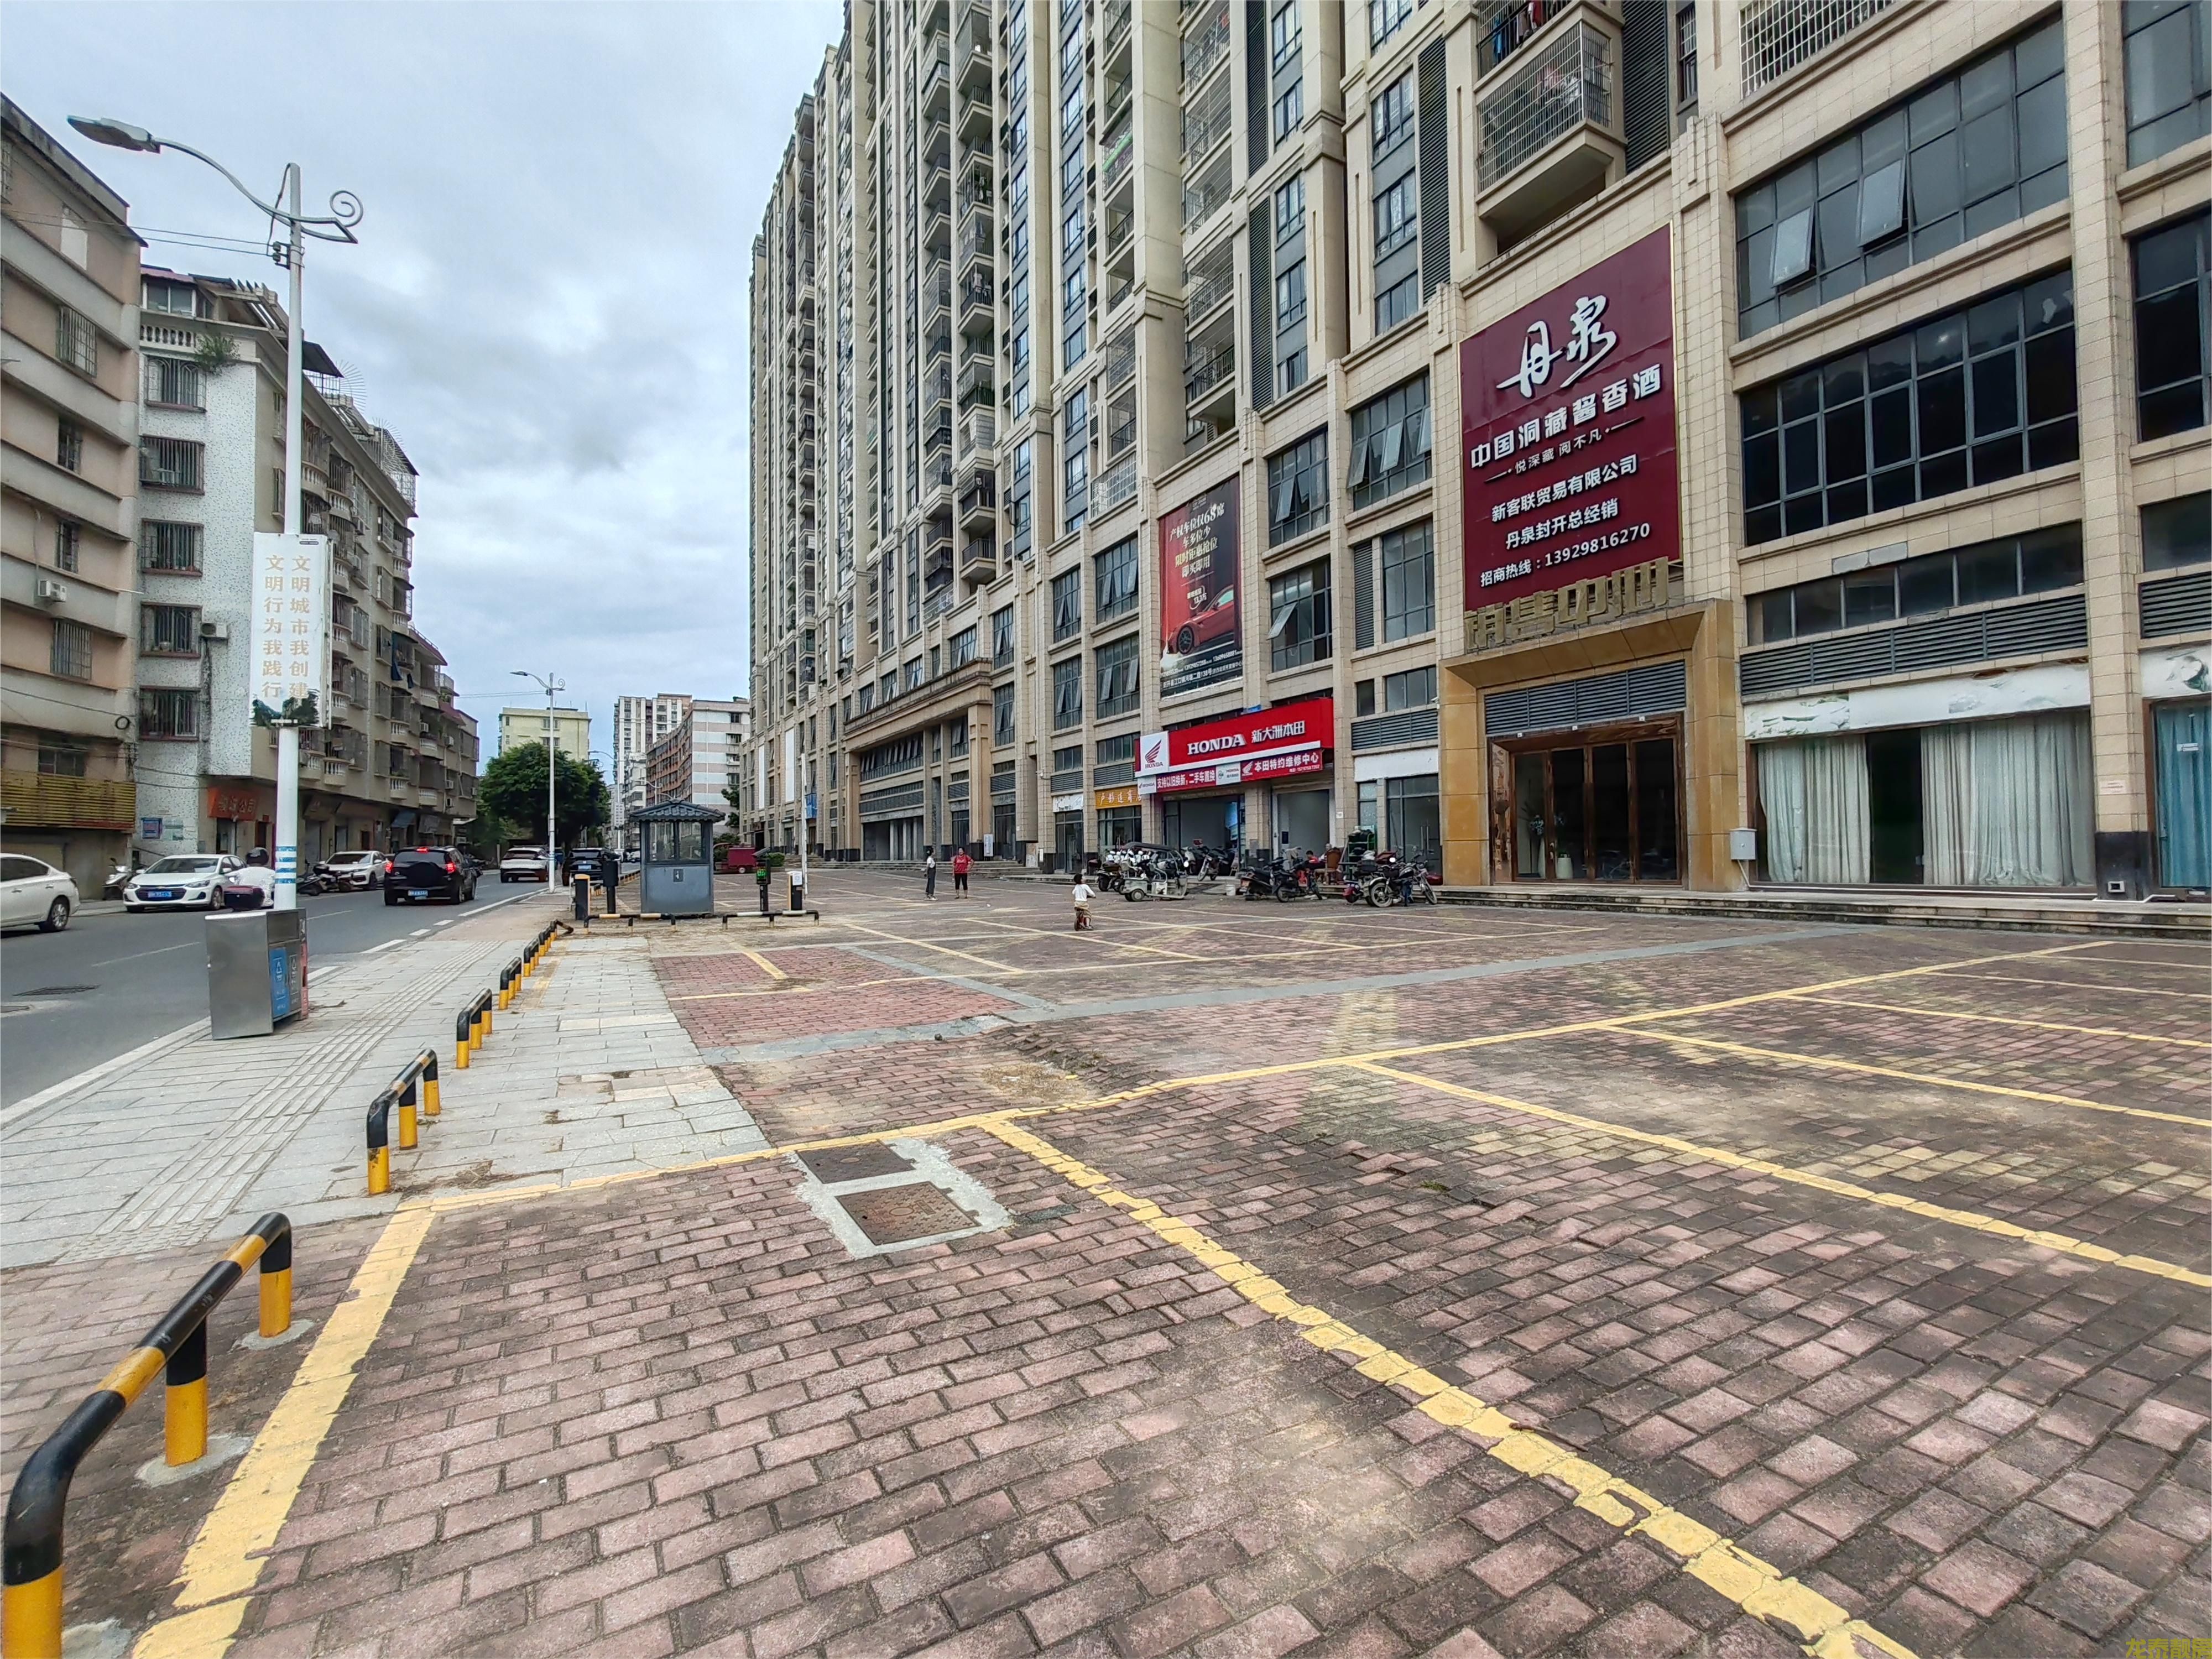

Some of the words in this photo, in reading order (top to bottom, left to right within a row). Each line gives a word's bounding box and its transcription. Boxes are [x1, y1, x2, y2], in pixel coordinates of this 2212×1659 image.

[1496, 295, 1618, 398] 丹泉
[1470, 363, 1661, 468] 中国洞藏酱香酒
[1492, 454, 1637, 522] 新客联贸易有限公司
[1505, 498, 1619, 550] 丹泉封开总经销
[262, 555, 284, 698] 文明行为我践行
[289, 555, 310, 700] 文明城市我创建
[1463, 556, 1668, 650] 销售中心
[1187, 734, 1245, 755] HONDA
[1251, 721, 1305, 743] 新大洲本田
[1254, 752, 1319, 773] 本田特约维修中心
